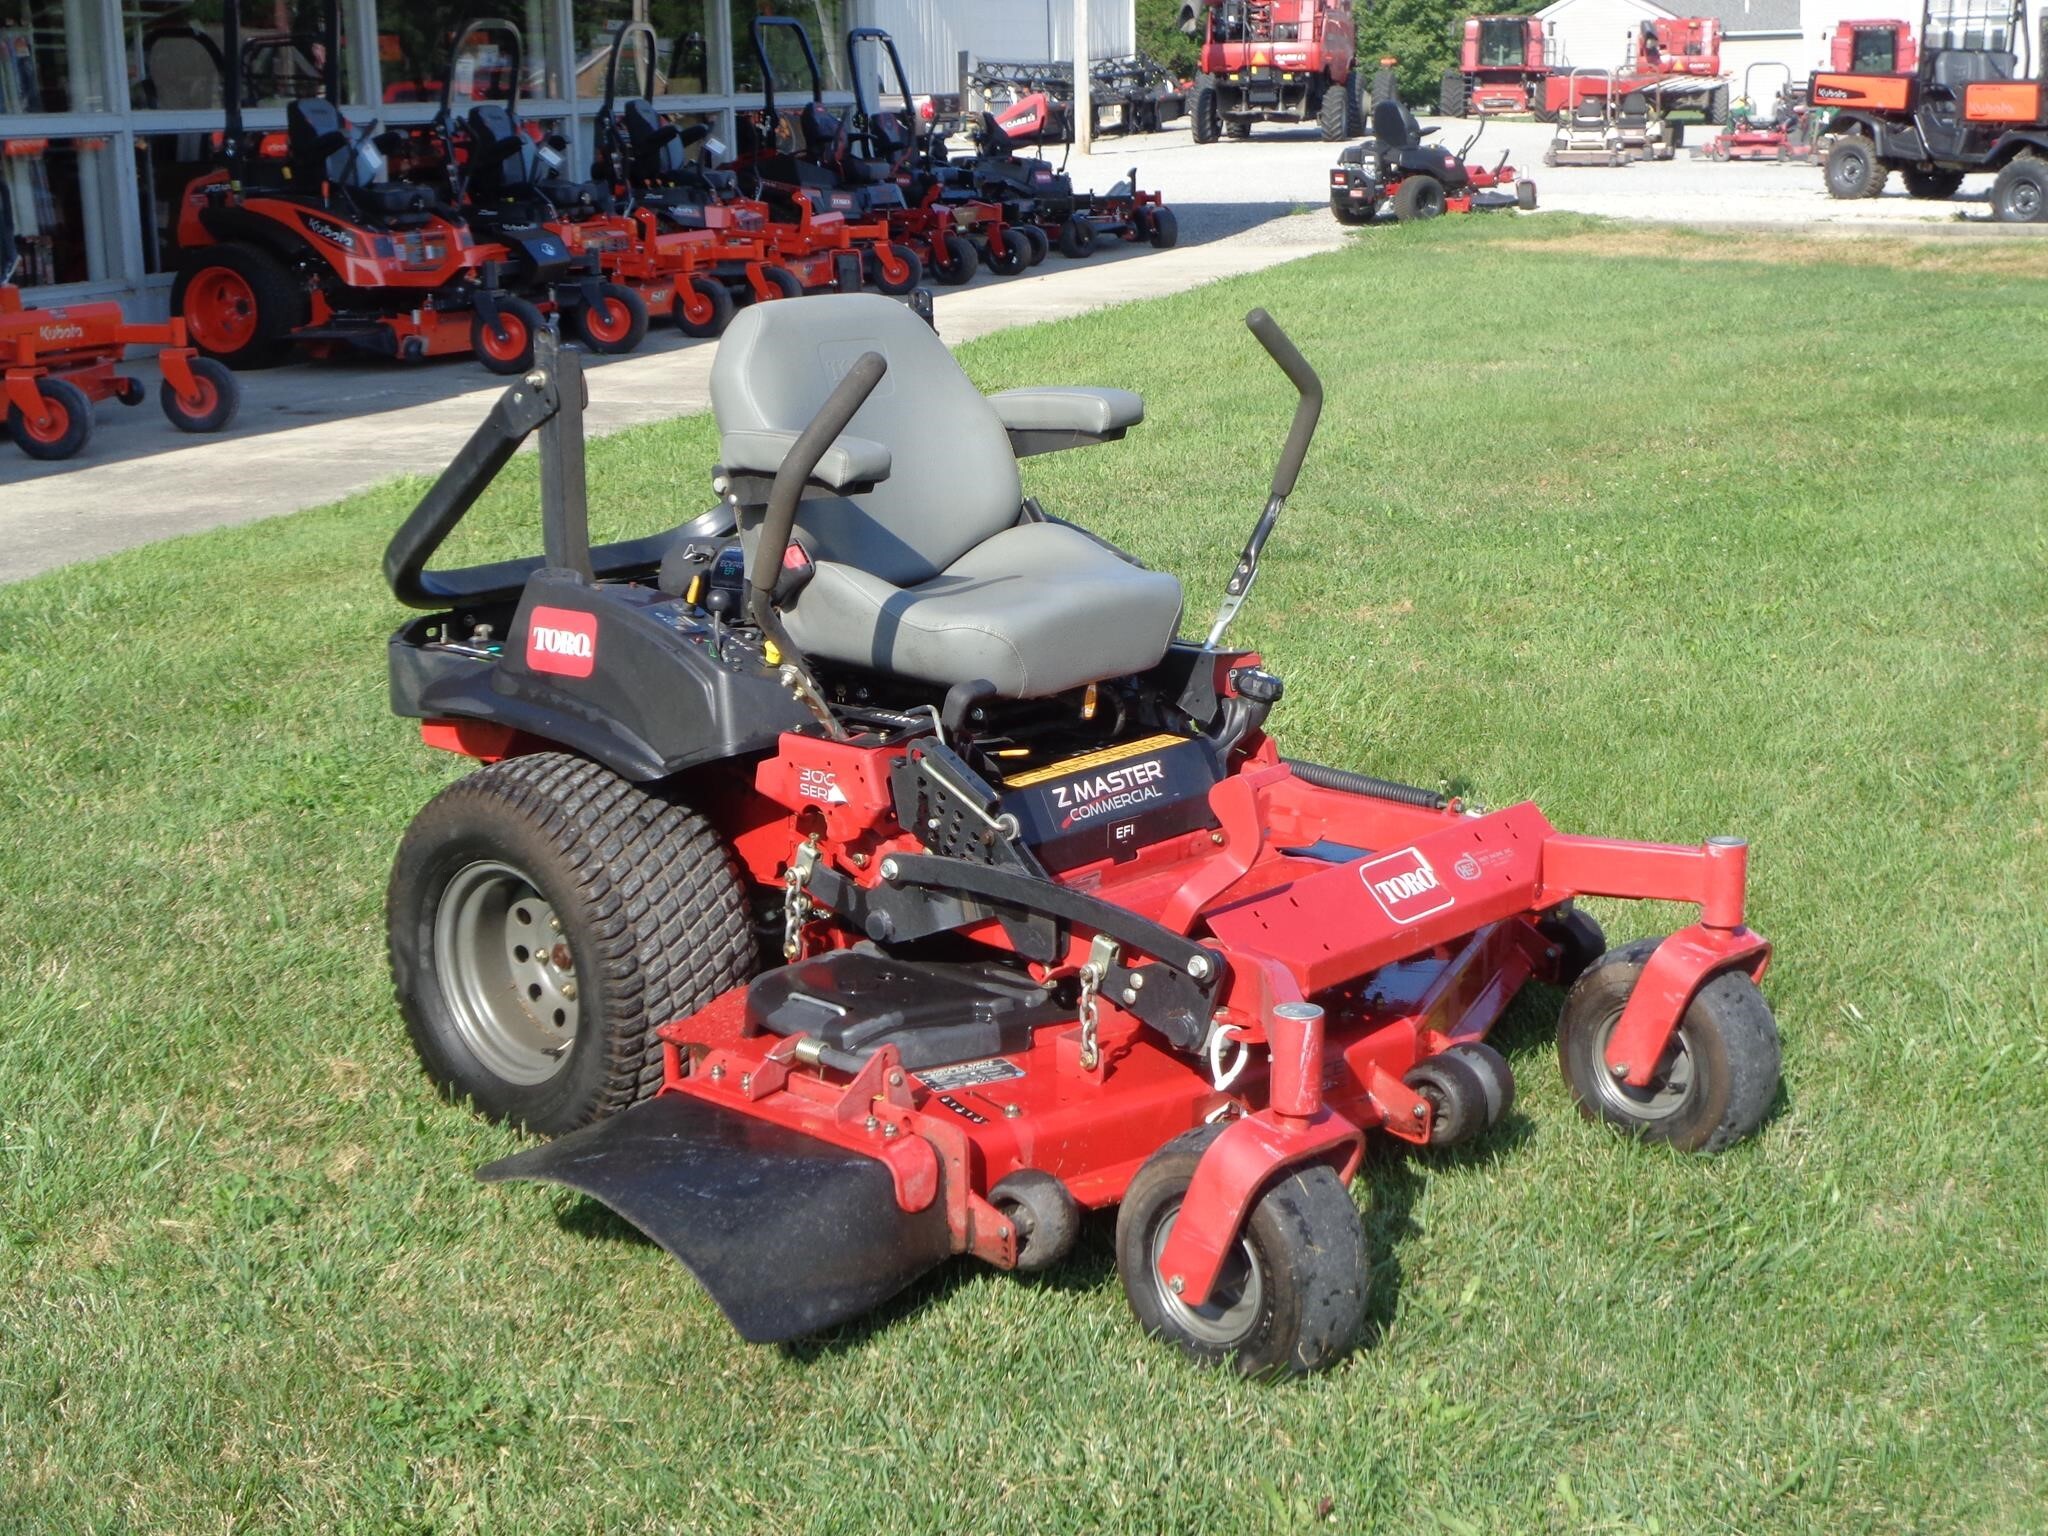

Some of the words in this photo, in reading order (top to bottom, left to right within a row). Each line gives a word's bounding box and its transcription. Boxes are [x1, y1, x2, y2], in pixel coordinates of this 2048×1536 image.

[1818, 87, 1848, 98] Kubota
[1006, 116, 1027, 129] CASE
[308, 217, 354, 247] Kubota
[40, 323, 83, 341] Kubota
[532, 626, 592, 658] TORO
[1051, 786, 1072, 808] Z
[1073, 760, 1164, 803] MASTER
[1070, 785, 1163, 821] COMMERCIAL
[1116, 824, 1135, 840] EFI
[1374, 866, 1440, 905] TORO
